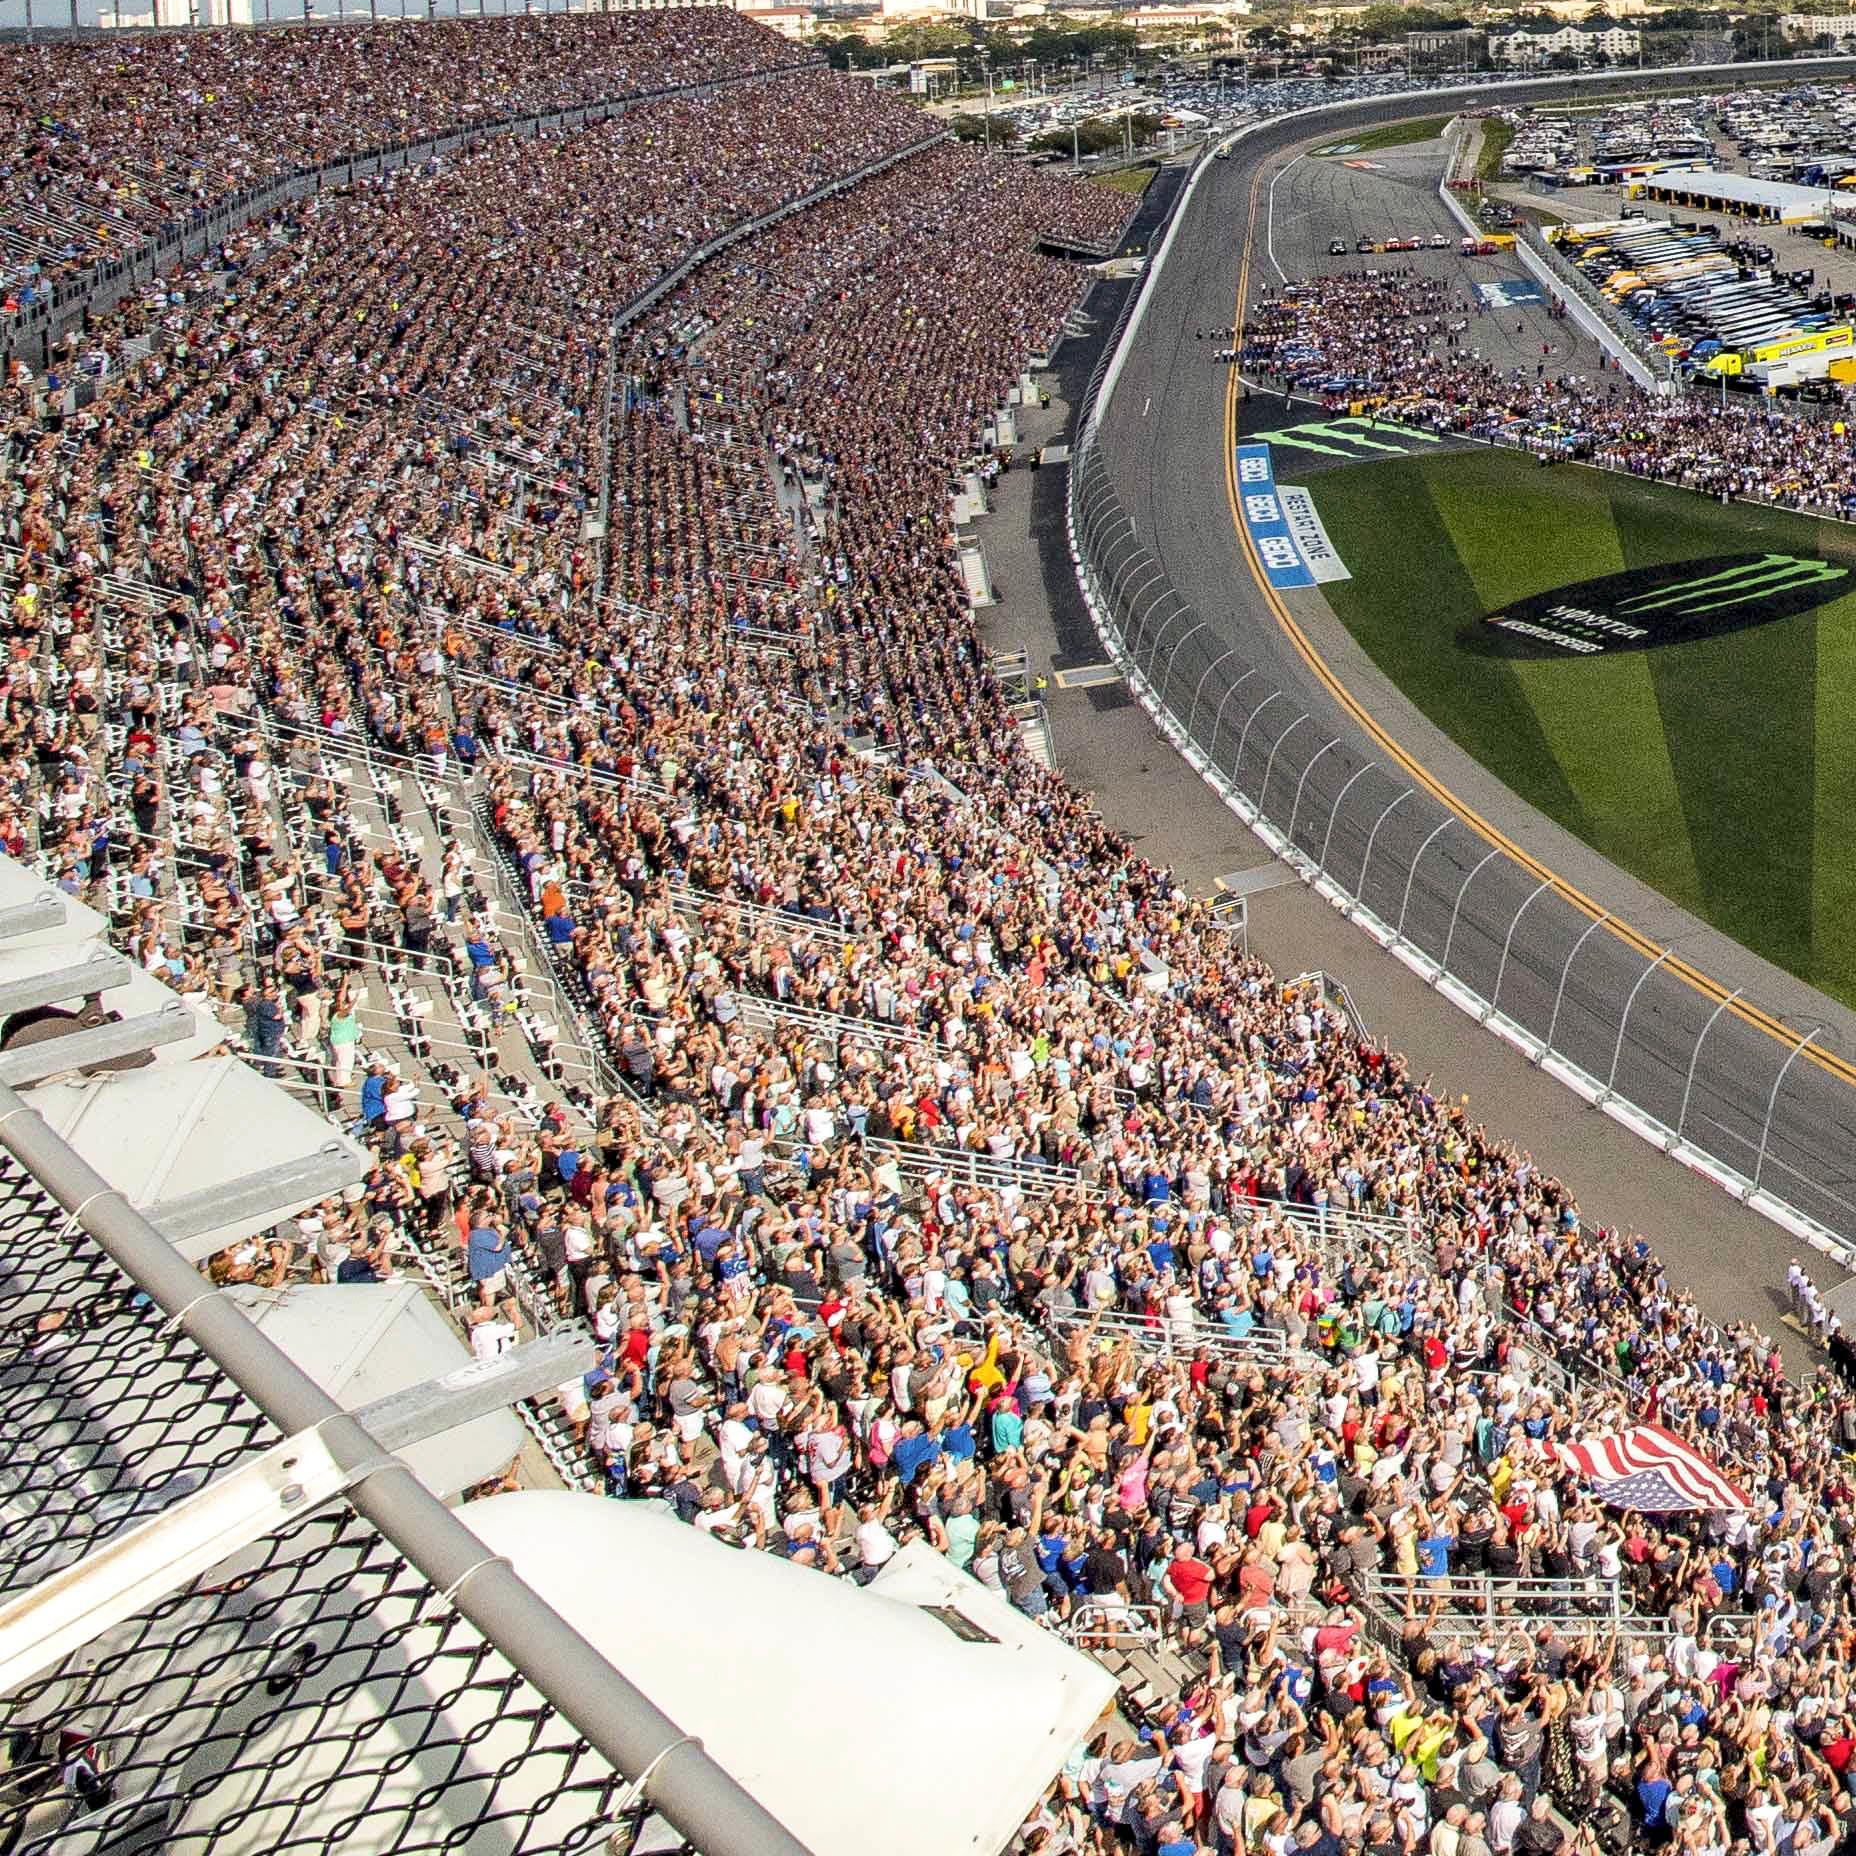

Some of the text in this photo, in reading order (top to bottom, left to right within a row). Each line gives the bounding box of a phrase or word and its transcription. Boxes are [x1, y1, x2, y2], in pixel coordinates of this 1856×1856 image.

[1239, 457, 1269, 482] GEICO
[1245, 494, 1280, 523] GEICO
[1286, 494, 1331, 561] RESTART ZONE
[1257, 536, 1300, 569] GEICO
[1546, 604, 1648, 640] MONSTER
